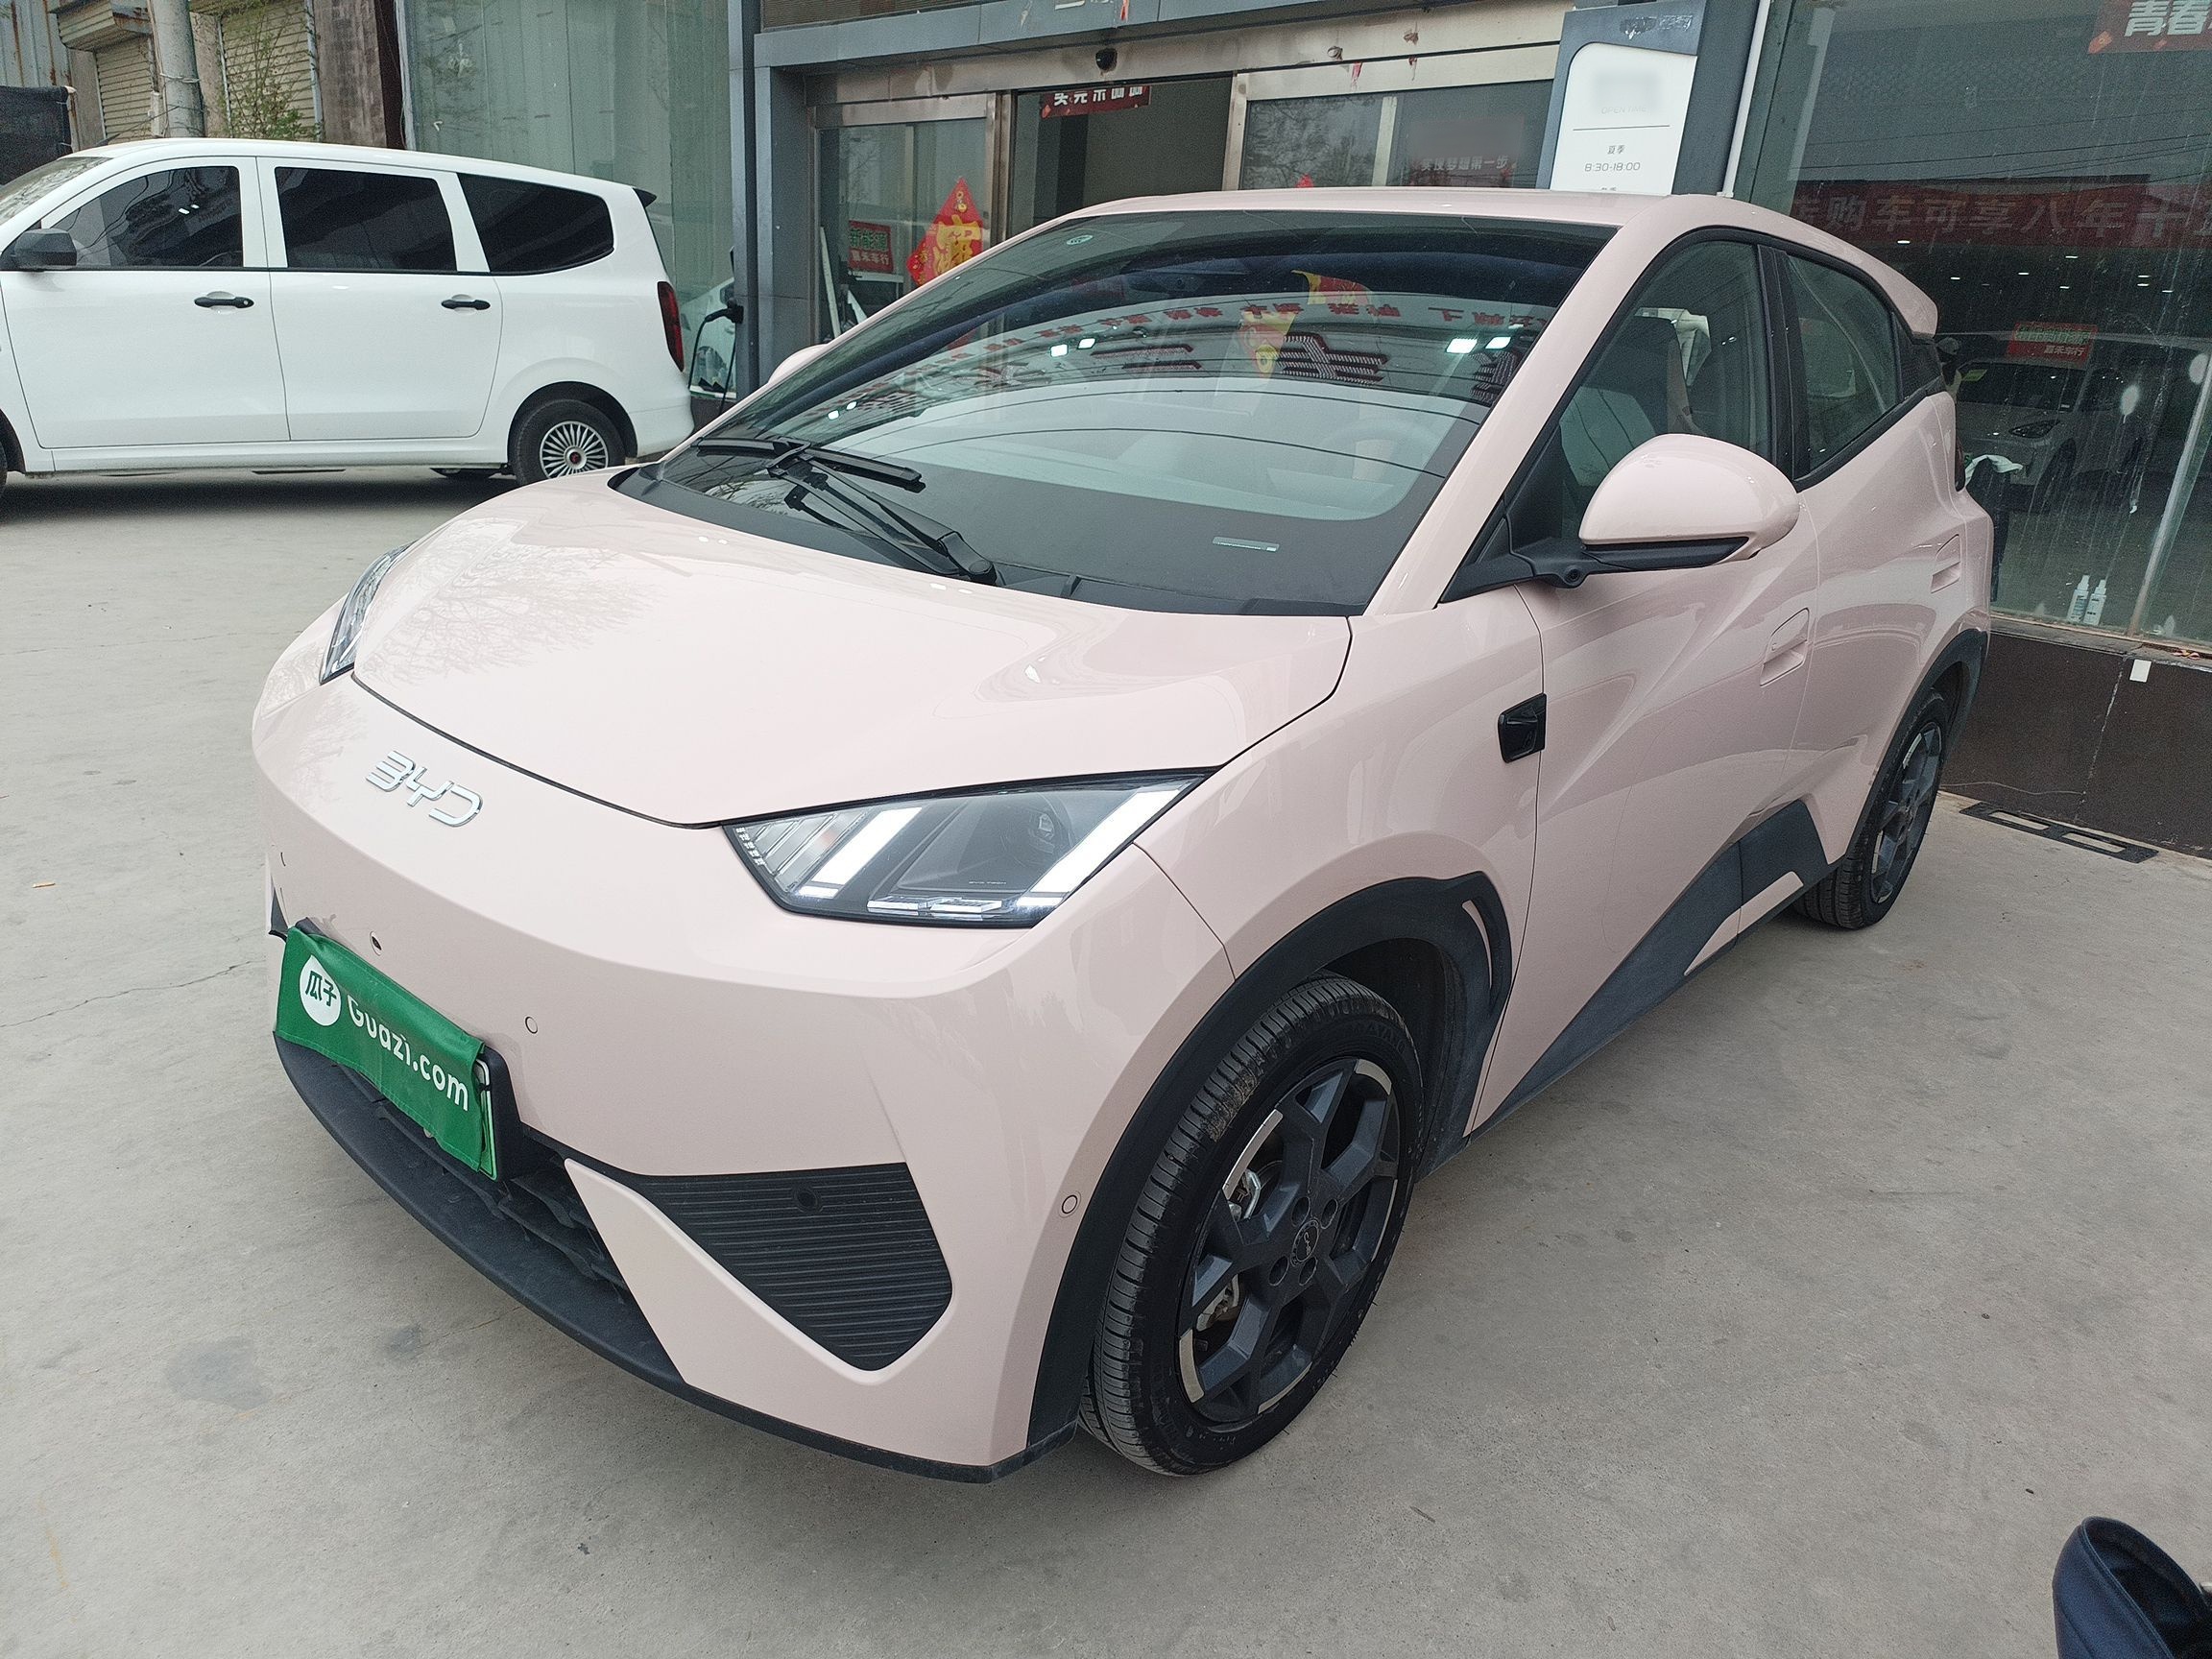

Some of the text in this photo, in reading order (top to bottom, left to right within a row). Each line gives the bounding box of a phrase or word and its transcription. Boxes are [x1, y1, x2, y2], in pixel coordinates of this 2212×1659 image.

[2124, 0, 2212, 36] 青春
[1584, 162, 1641, 172] 8:30-18:00
[1607, 145, 1624, 155] 夏季
[366, 751, 483, 828] BYD
[304, 970, 338, 1008] 瓜子
[347, 995, 469, 1112] Guazi.com
